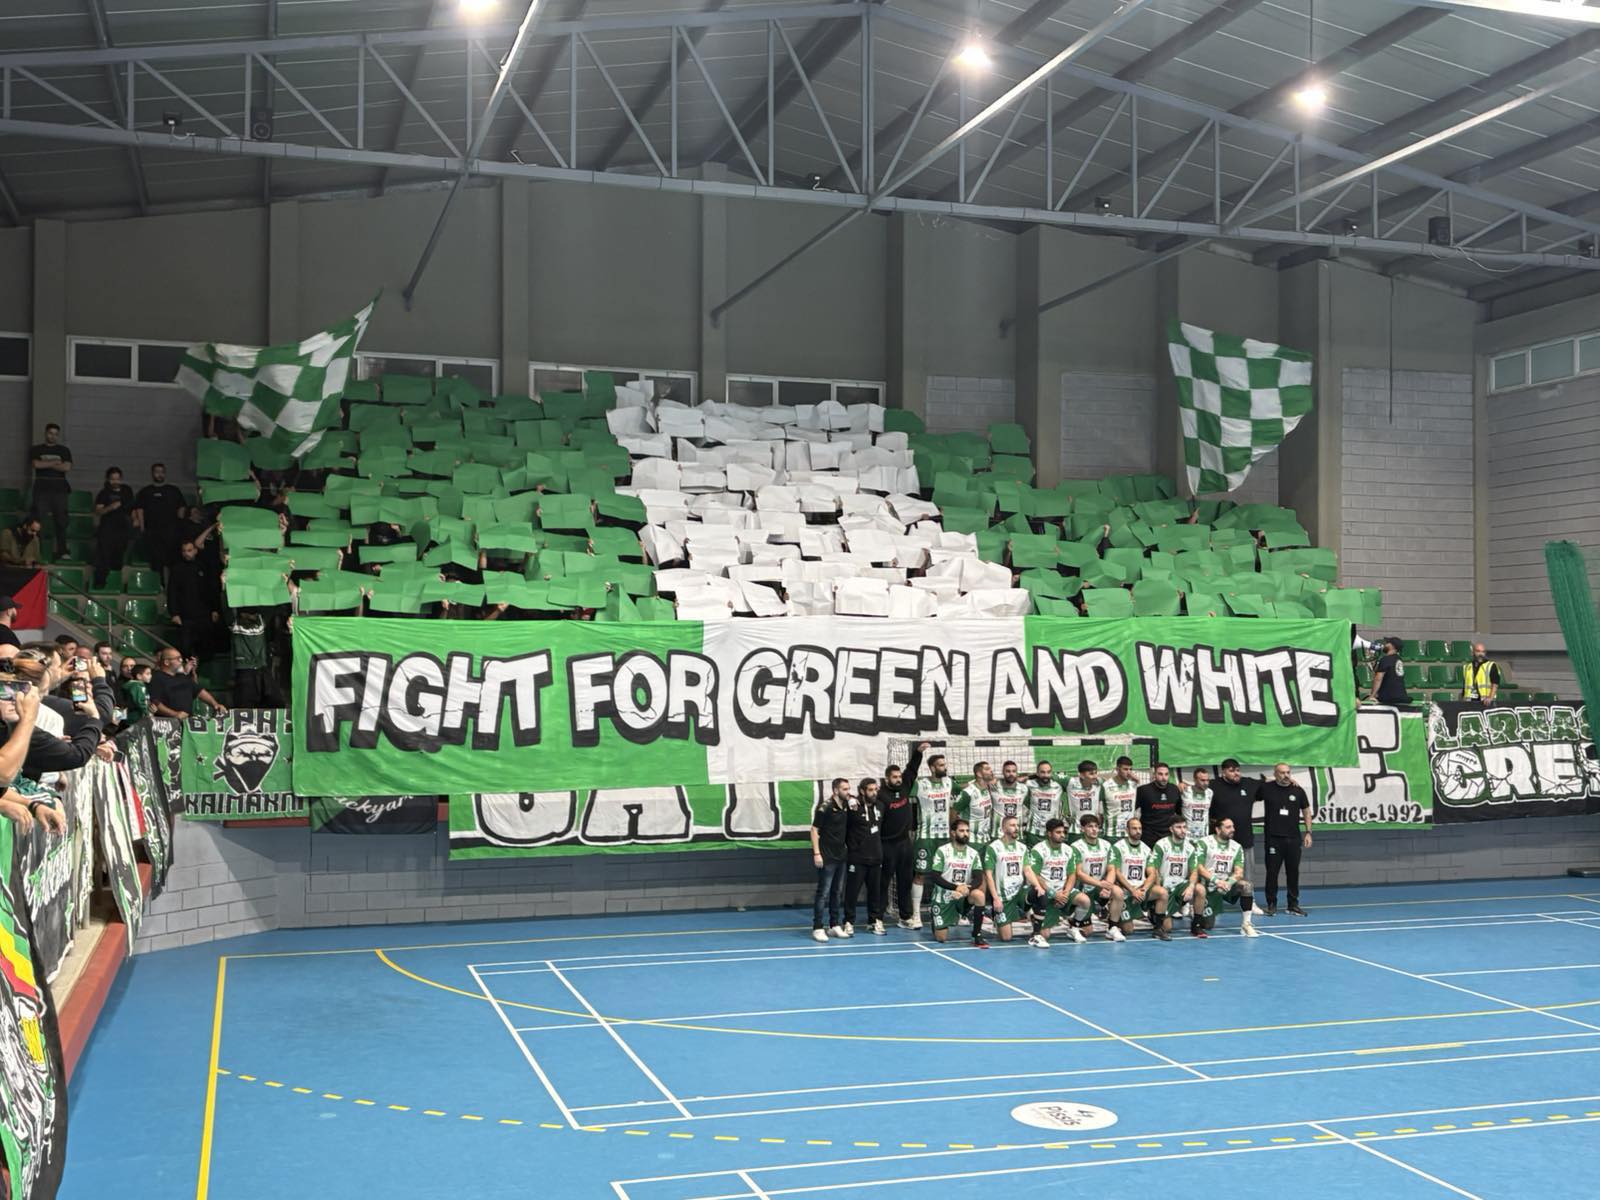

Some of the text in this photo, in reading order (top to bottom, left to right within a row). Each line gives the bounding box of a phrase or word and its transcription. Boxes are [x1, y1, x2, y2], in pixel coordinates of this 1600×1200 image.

[308, 641, 1340, 752] FIGHT FOR GREEN AND WHITE
[1318, 803, 1423, 823] since-1992
[933, 915, 943, 927] 16
